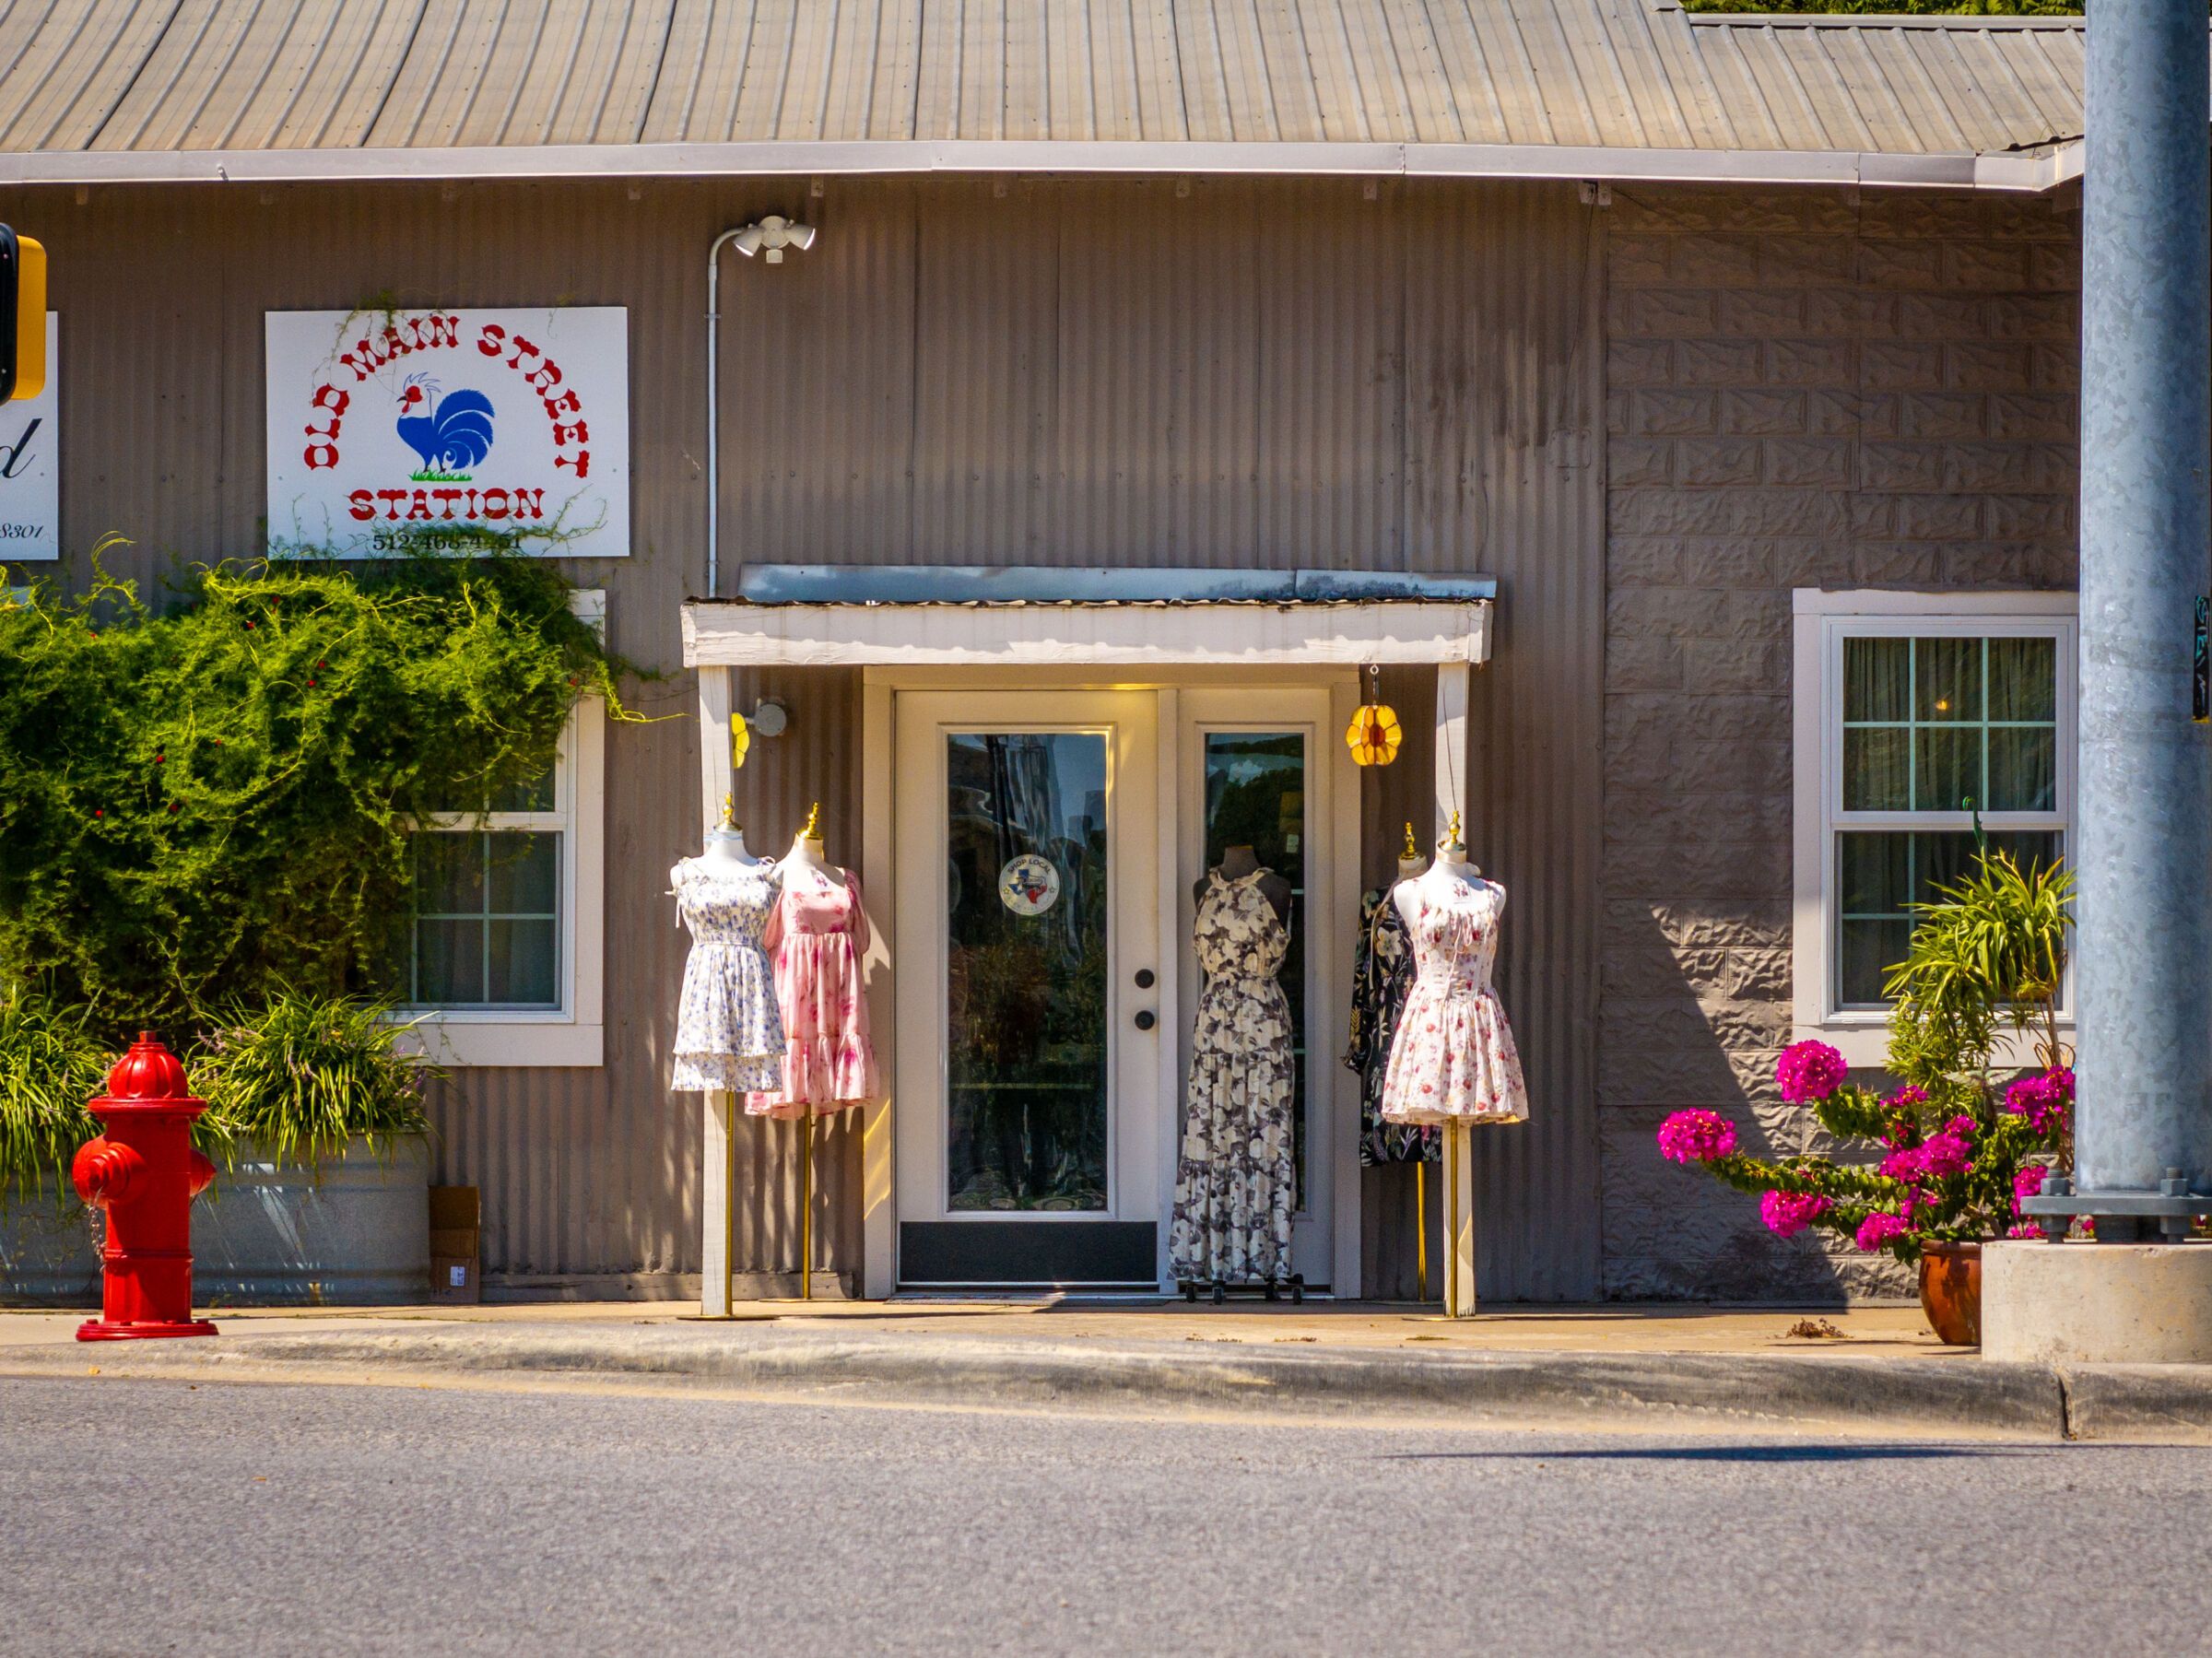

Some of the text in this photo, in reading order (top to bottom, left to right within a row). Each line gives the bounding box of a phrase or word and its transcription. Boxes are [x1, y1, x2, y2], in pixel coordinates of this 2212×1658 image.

[303, 315, 591, 478] OLD MAIN STREET
[347, 488, 547, 522] STATION
[1007, 858, 1051, 875] SHOP LOCAL
